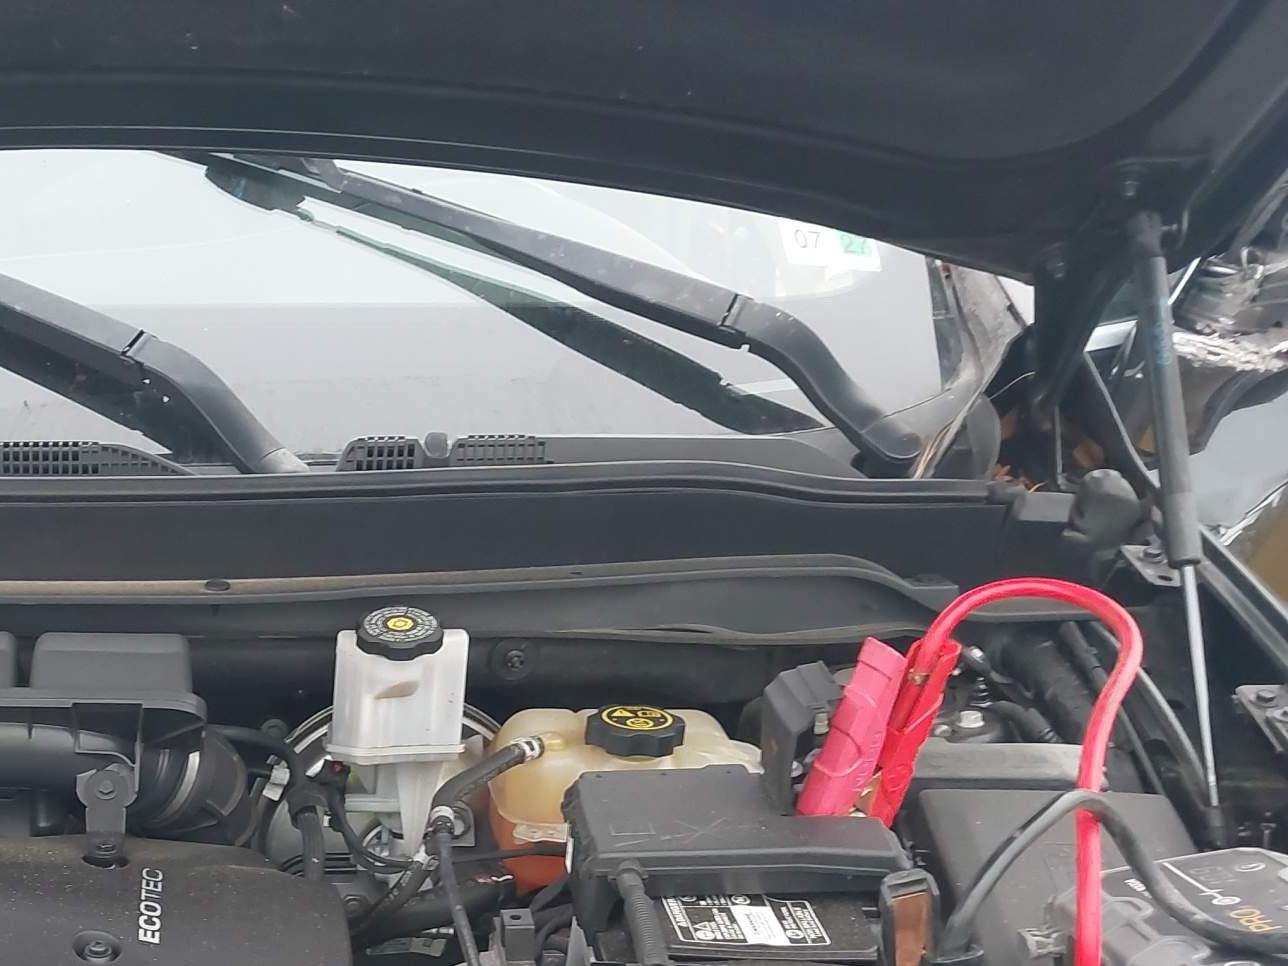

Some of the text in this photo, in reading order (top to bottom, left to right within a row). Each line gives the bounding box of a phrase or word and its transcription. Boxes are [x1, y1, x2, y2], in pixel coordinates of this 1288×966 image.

[794, 229, 820, 249] 07
[138, 867, 164, 944] ECOTEC
[1229, 907, 1282, 933] PRO
